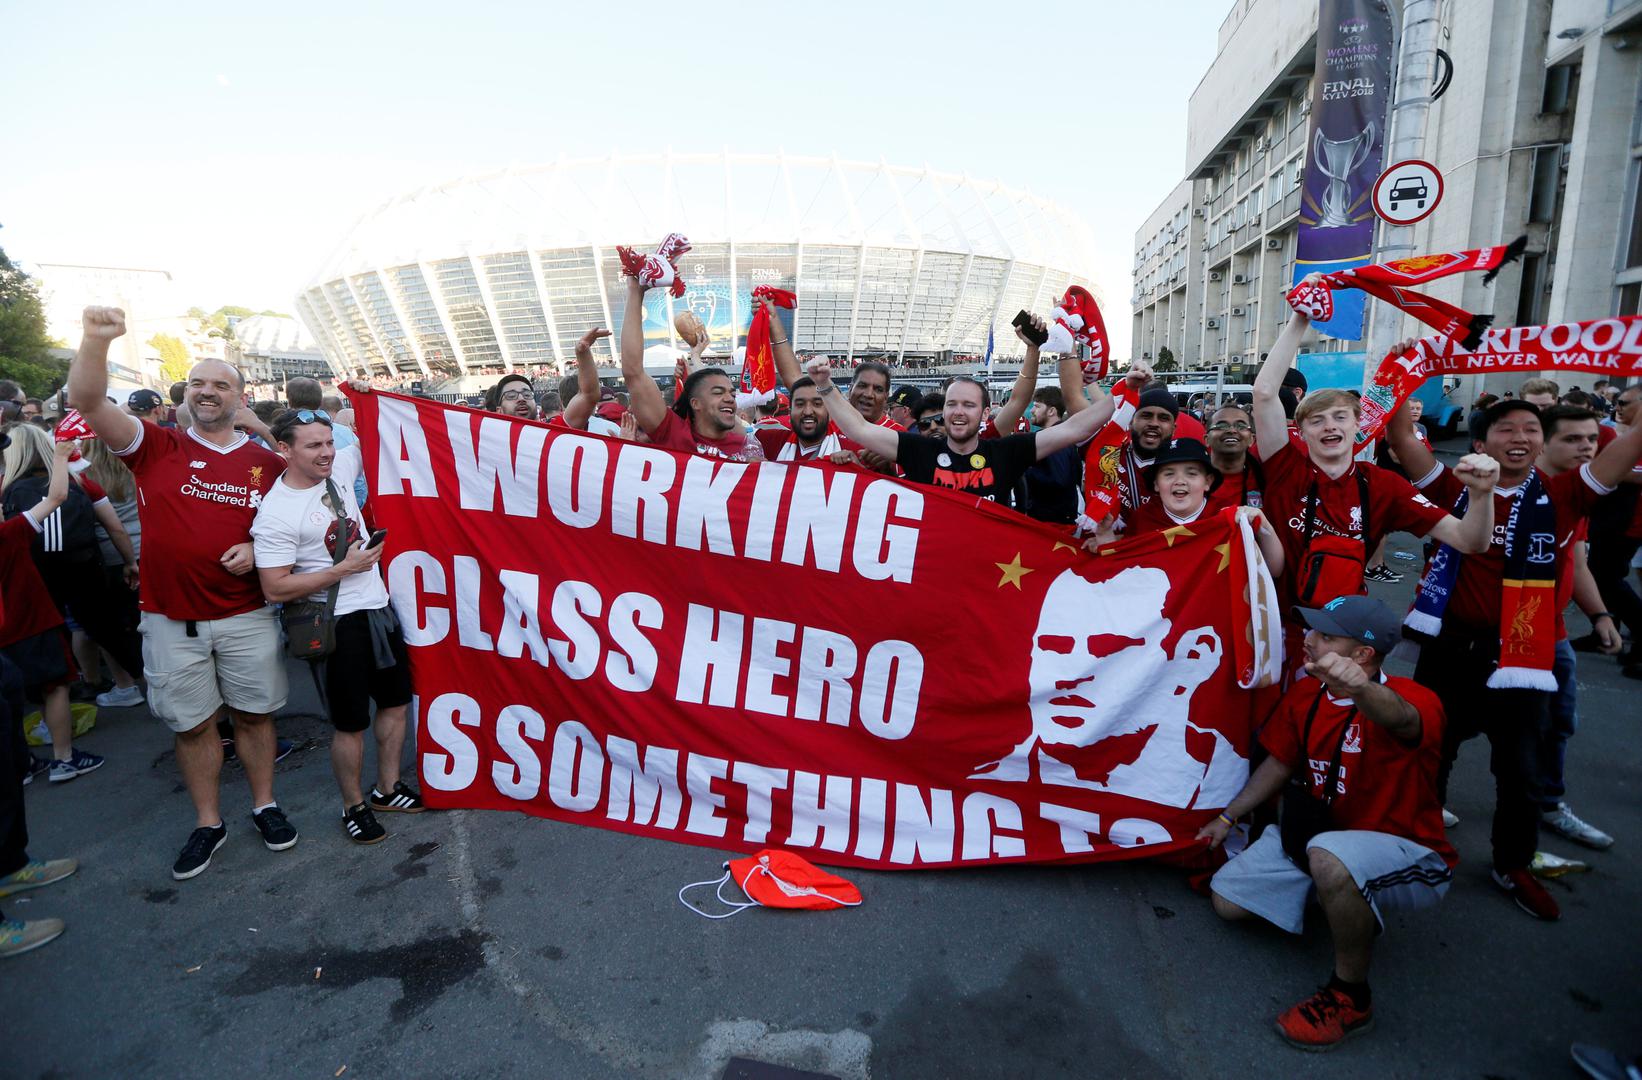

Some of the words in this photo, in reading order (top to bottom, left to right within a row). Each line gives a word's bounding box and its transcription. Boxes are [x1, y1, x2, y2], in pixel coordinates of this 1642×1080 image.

[1327, 44, 1379, 58] WOMEN'S
[1325, 54, 1377, 66] CHAMPIONS
[1323, 77, 1375, 93] FINAL
[1322, 90, 1349, 101] KYIV
[1350, 88, 1374, 98] 2018
[1467, 353, 1538, 369] NEVER
[1552, 352, 1621, 368] WALK
[180, 484, 246, 507] Chartered
[376, 394, 439, 498] A
[444, 409, 925, 584] WORKING
[387, 550, 664, 692] CLASS
[675, 602, 925, 740] HERO
[491, 704, 1026, 865] SOMETHING
